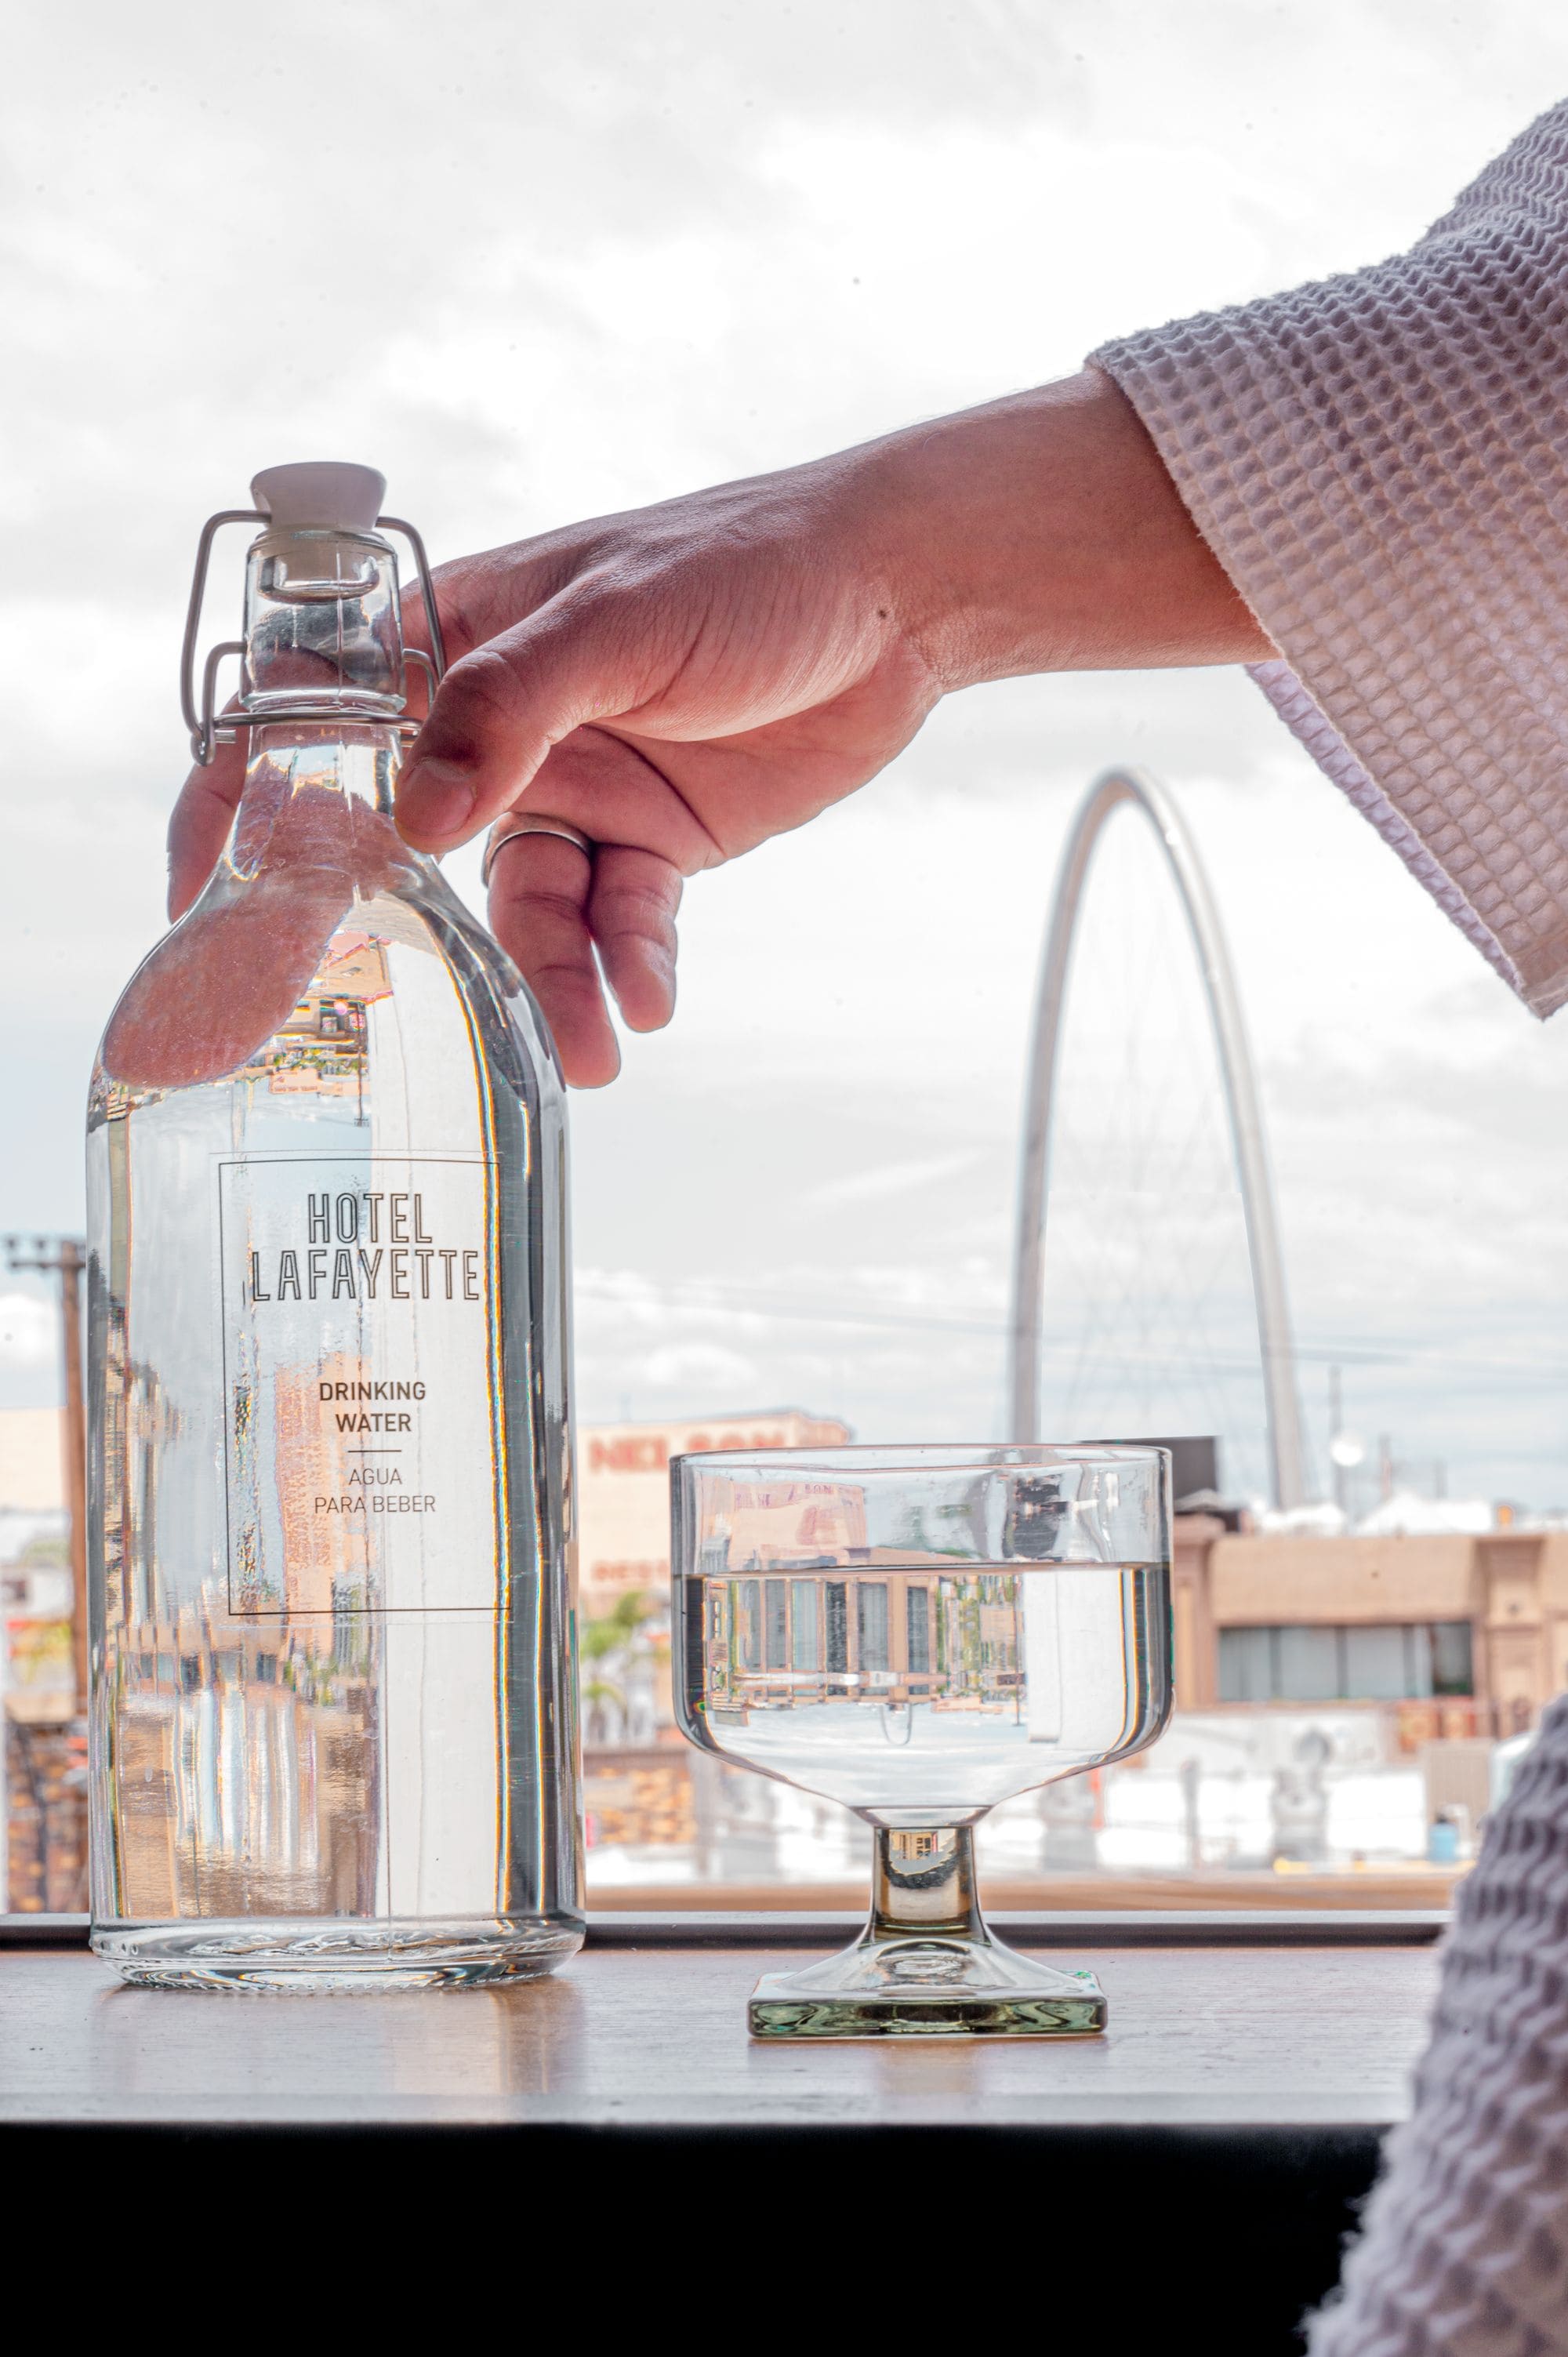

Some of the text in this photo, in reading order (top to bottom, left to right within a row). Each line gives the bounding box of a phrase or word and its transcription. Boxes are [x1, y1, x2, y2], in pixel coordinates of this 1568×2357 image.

[307, 1193, 433, 1244] HOTEL
[252, 1248, 480, 1302] LAFAYETTE
[319, 1381, 426, 1401] DRINKING
[335, 1413, 412, 1433] WATER
[348, 1468, 403, 1486] AGUA
[314, 1494, 436, 1514] PARA BEBER
